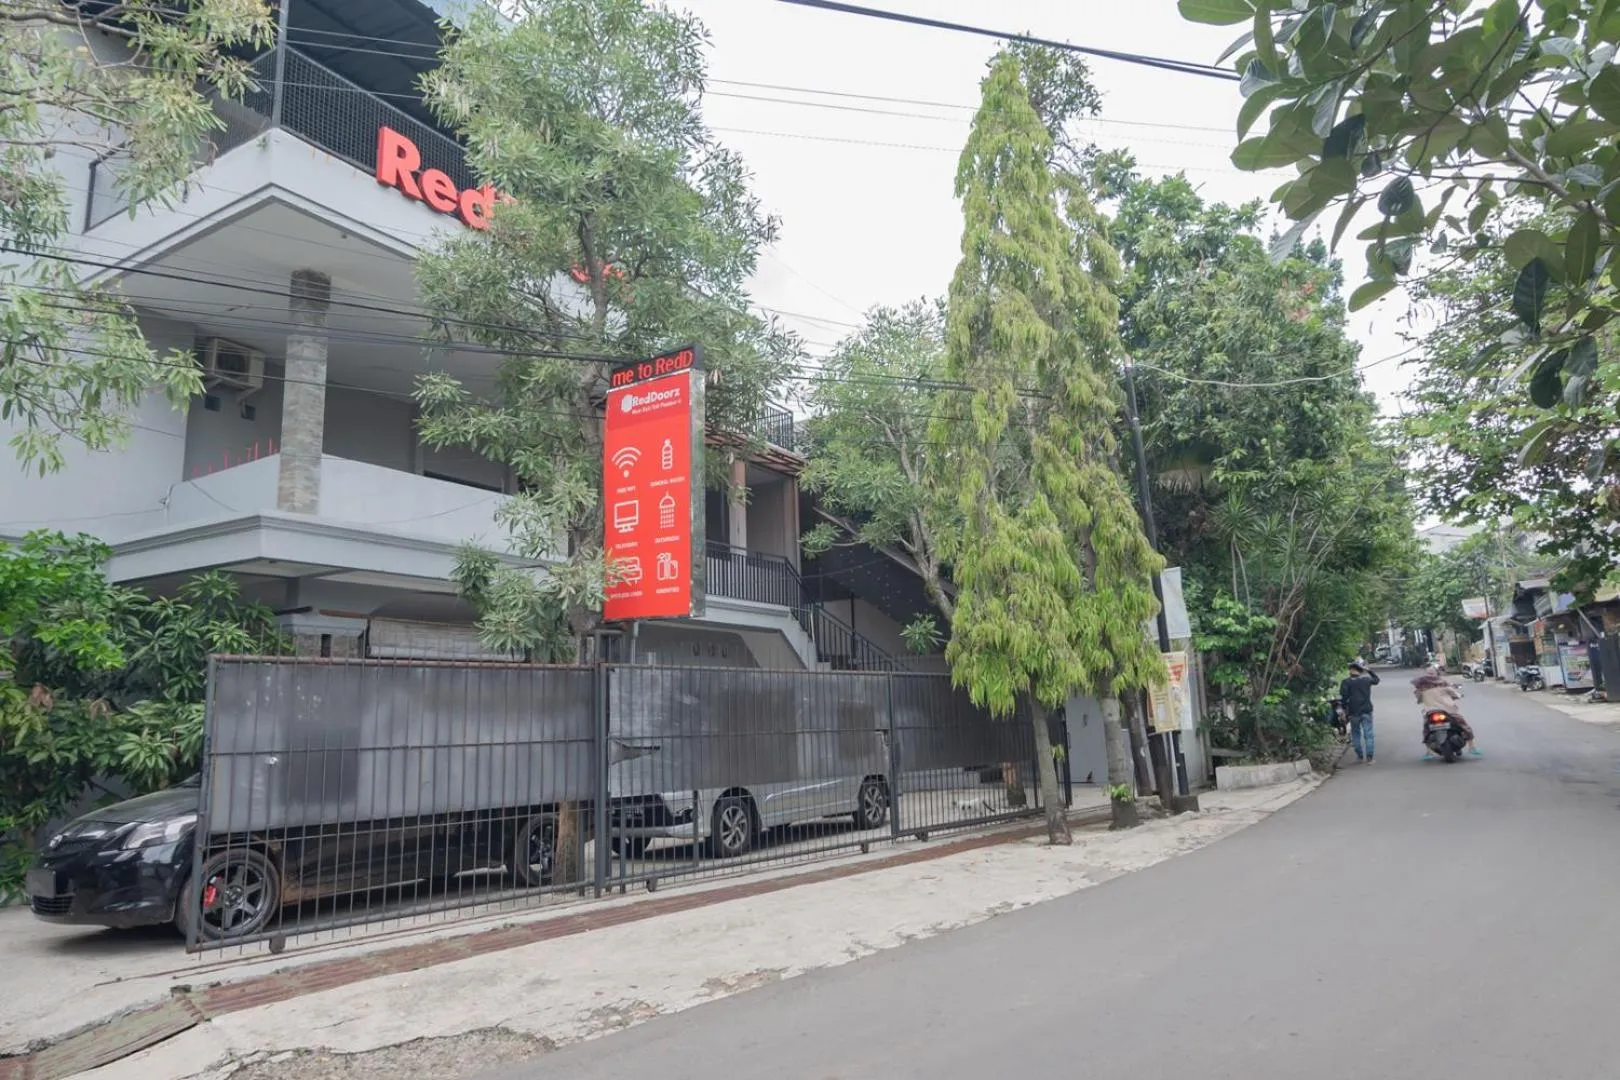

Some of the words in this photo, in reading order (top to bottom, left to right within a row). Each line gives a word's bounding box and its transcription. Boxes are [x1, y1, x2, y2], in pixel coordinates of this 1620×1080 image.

[612, 369, 634, 387] me
[638, 363, 653, 379] to
[655, 350, 693, 375] RedD
[632, 387, 680, 407] RedDoorz
